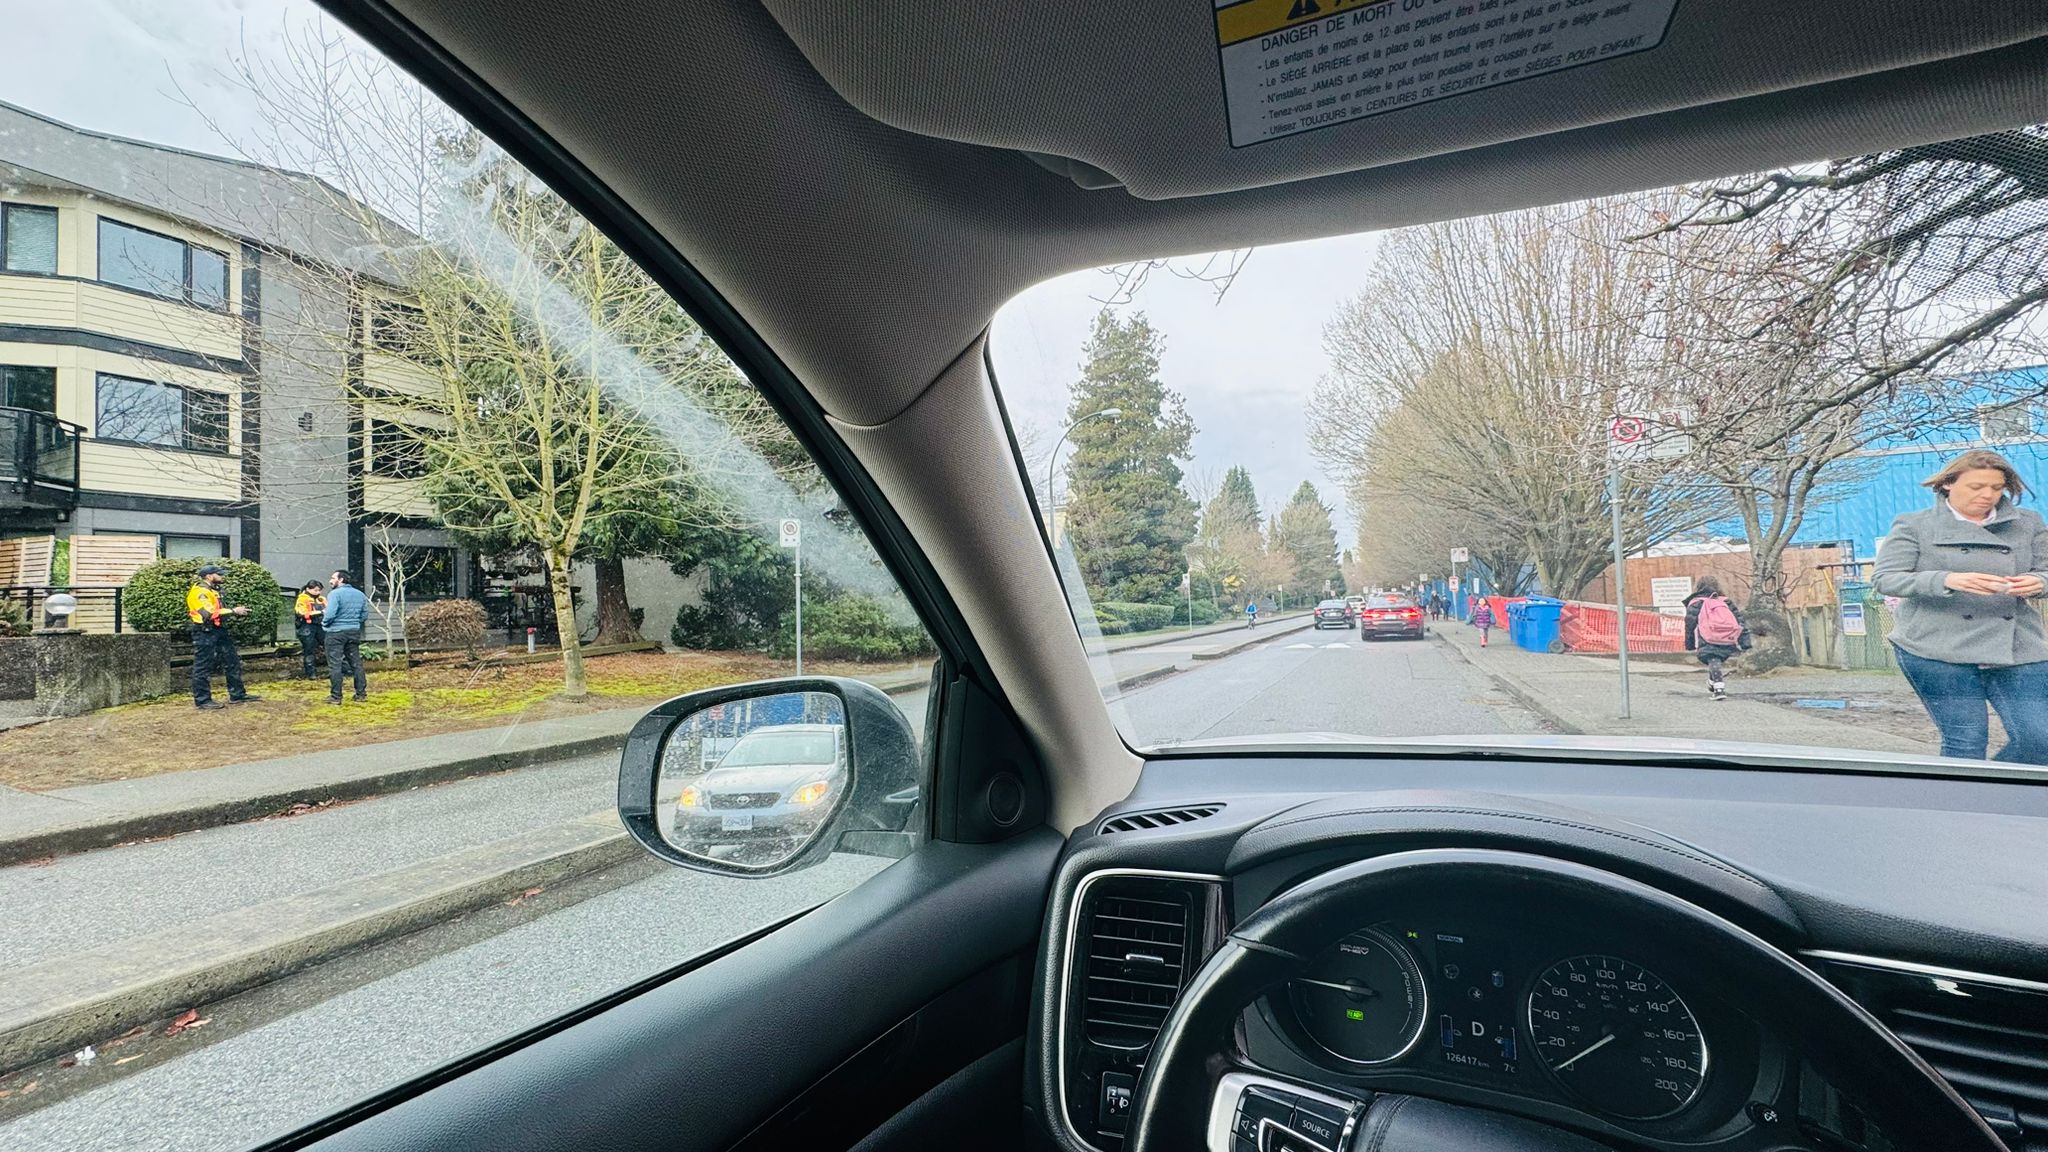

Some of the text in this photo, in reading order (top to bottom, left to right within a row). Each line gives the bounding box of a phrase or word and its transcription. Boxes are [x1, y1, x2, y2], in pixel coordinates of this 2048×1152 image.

[1261, 24, 1318, 52] DANGER
[1326, 16, 1345, 33] DE
[1353, 2, 1396, 26] MORT
[1264, 59, 1280, 70] Les
[1284, 49, 1314, 65] enfants
[1318, 43, 1329, 56] de
[1333, 36, 1359, 51] moins
[1362, 32, 1374, 43] de
[1380, 26, 1390, 39] 12
[1394, 22, 1411, 35] ans
[1414, 10, 1452, 31] peuvent
[1455, 5, 1474, 18] être
[1266, 78, 1277, 88] Le
[1356, 52, 1369, 63] est
[1373, 49, 1382, 59] la
[1385, 42, 1410, 58] place
[1413, 36, 1426, 48] où
[1429, 32, 1443, 44] les
[1447, 23, 1481, 40] enfants
[1484, 16, 1506, 30] sont
[1510, 12, 1519, 23] le
[1522, 7, 1543, 22] plus
[1548, 2, 1561, 13] en
[1267, 86, 1307, 104] N'installez
[1311, 75, 1343, 92] JAMAIS
[1347, 73, 1358, 83] un
[1361, 66, 1385, 80] siège
[1388, 60, 1408, 75] pour
[1412, 52, 1439, 67] enfant
[1443, 43, 1471, 59] tourné
[1475, 38, 1495, 50] vers
[1538, 22, 1556, 34] sur
[1268, 103, 1313, 119] Tenez-vous
[1316, 96, 1337, 108] assis
[1340, 92, 1352, 102] en
[1385, 80, 1393, 91] le
[1397, 77, 1415, 90] plus
[1419, 71, 1434, 83] loin
[1437, 61, 1474, 80] possible
[1478, 57, 1490, 68] du
[1493, 48, 1528, 64] coussin
[1270, 121, 1297, 135] Utilisez
[1300, 108, 1347, 127] TOUJOURS
[1366, 91, 1418, 112] CEINTURES
[1422, 86, 1436, 98] DE
[1490, 71, 1501, 81] et
[1503, 67, 1520, 78] des
[1567, 46, 1598, 62] POUR
[1569, 973, 1587, 983] 80
[1595, 969, 1616, 980] 100
[1551, 987, 1568, 998] 60
[1625, 980, 1647, 992] 120
[1646, 1001, 1669, 1013] 140
[1543, 1009, 1560, 1020] 40
[1471, 1021, 1485, 1036] D
[1662, 1028, 1685, 1041] 160
[1549, 1036, 1566, 1047] 20
[1446, 1052, 1478, 1066] 126417
[1664, 1057, 1687, 1069] 180
[1654, 1079, 1678, 1091] 200
[1301, 1118, 1331, 1140] SOURCE
